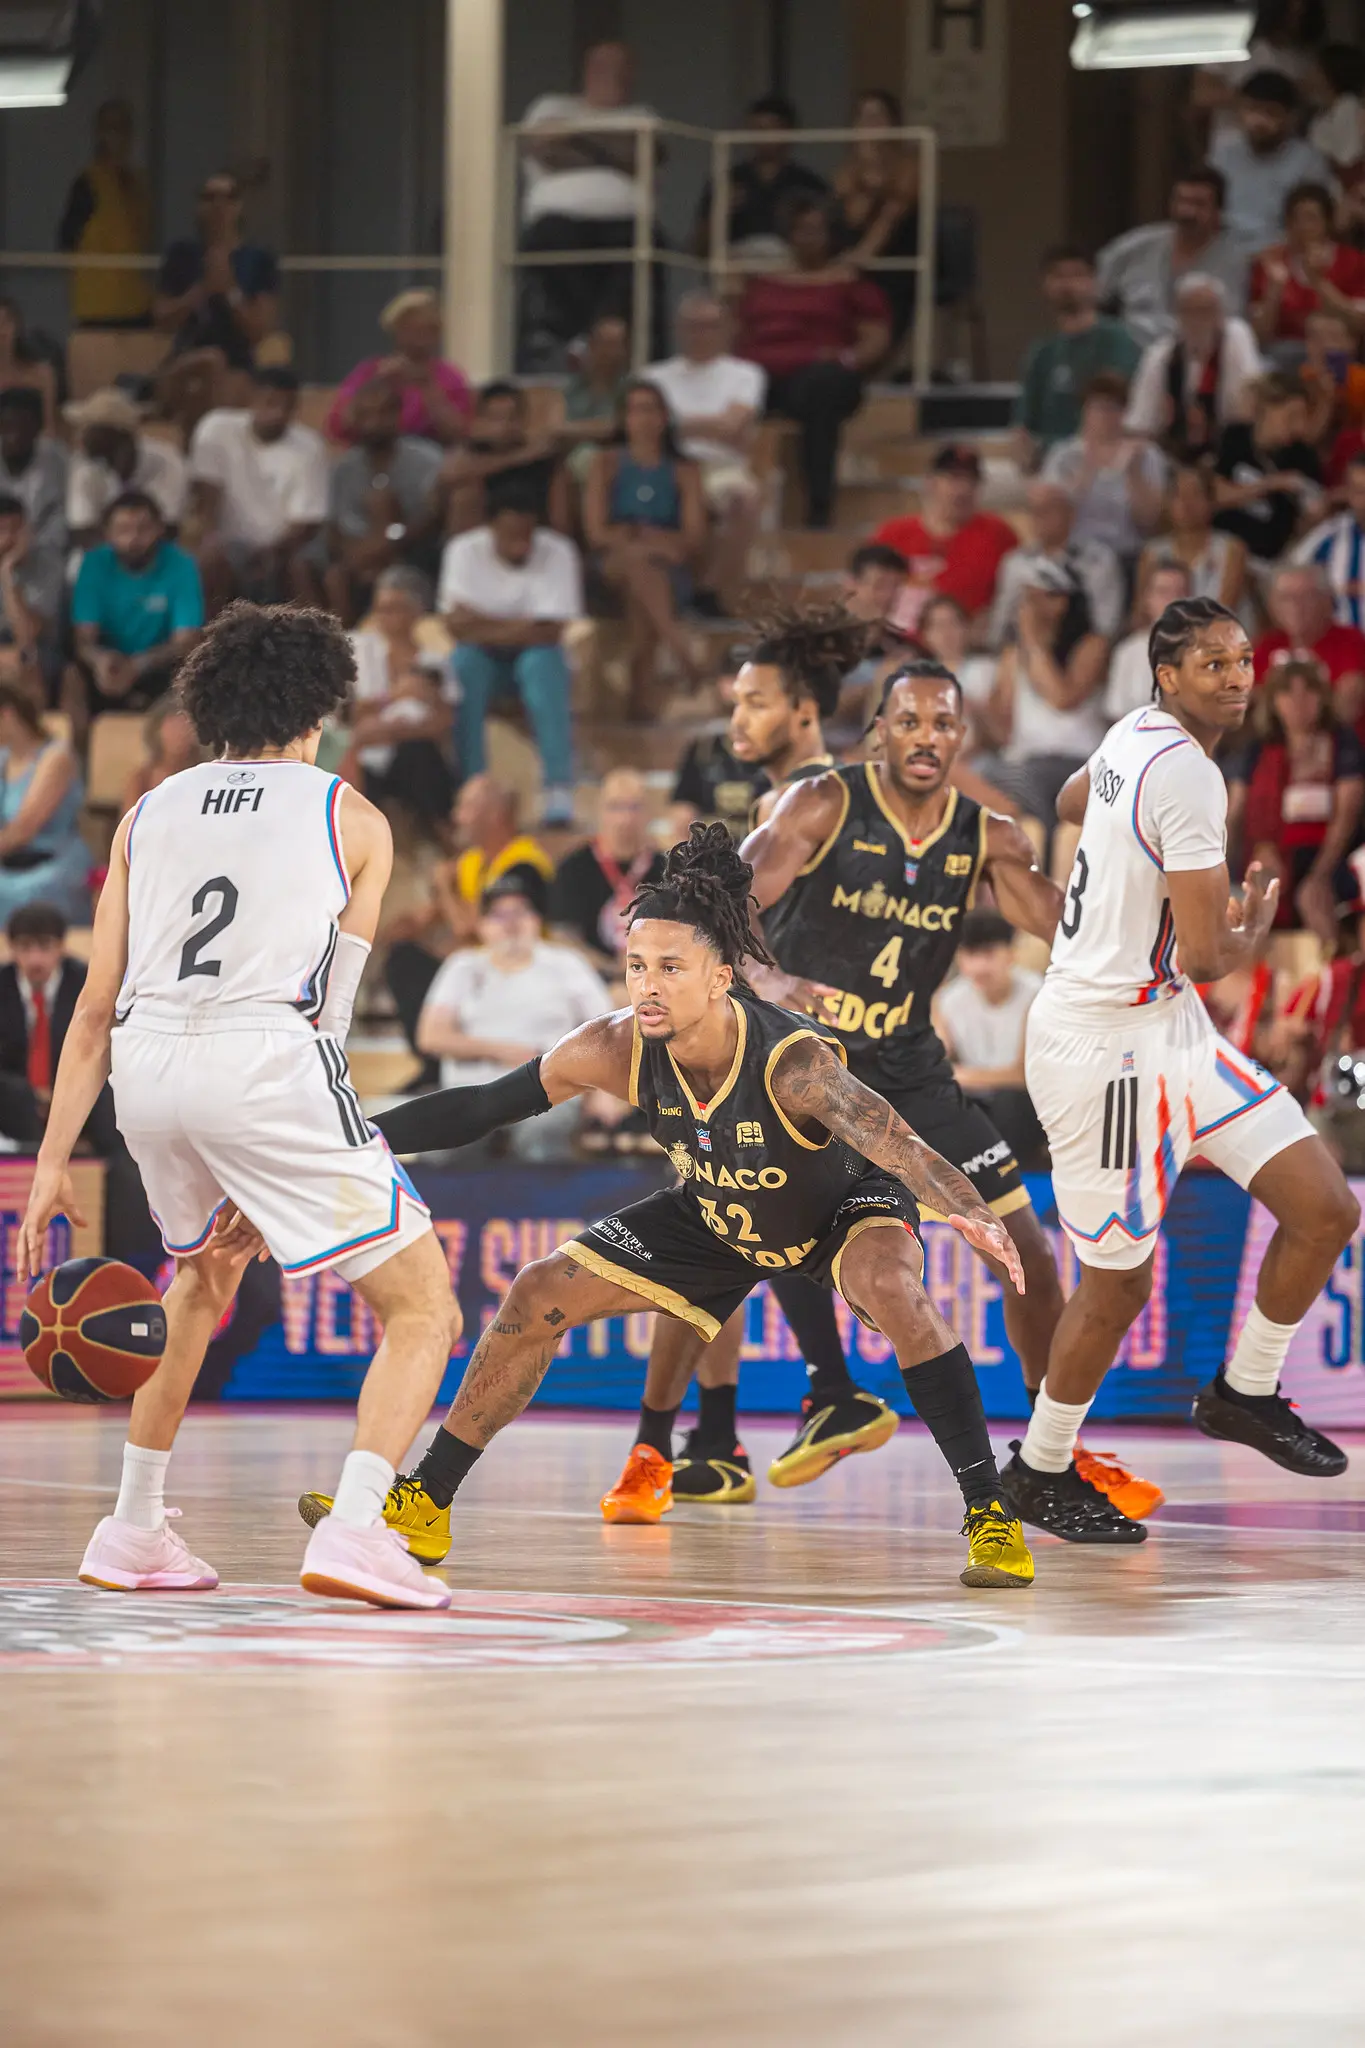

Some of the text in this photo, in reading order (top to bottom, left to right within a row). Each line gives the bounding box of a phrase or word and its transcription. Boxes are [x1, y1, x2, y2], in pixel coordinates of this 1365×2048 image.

[200, 787, 265, 815] HIFI
[178, 876, 239, 982] 2
[870, 935, 904, 989] 4
[607, 1217, 645, 1251] GROUPE
[696, 1195, 762, 1242] 32
